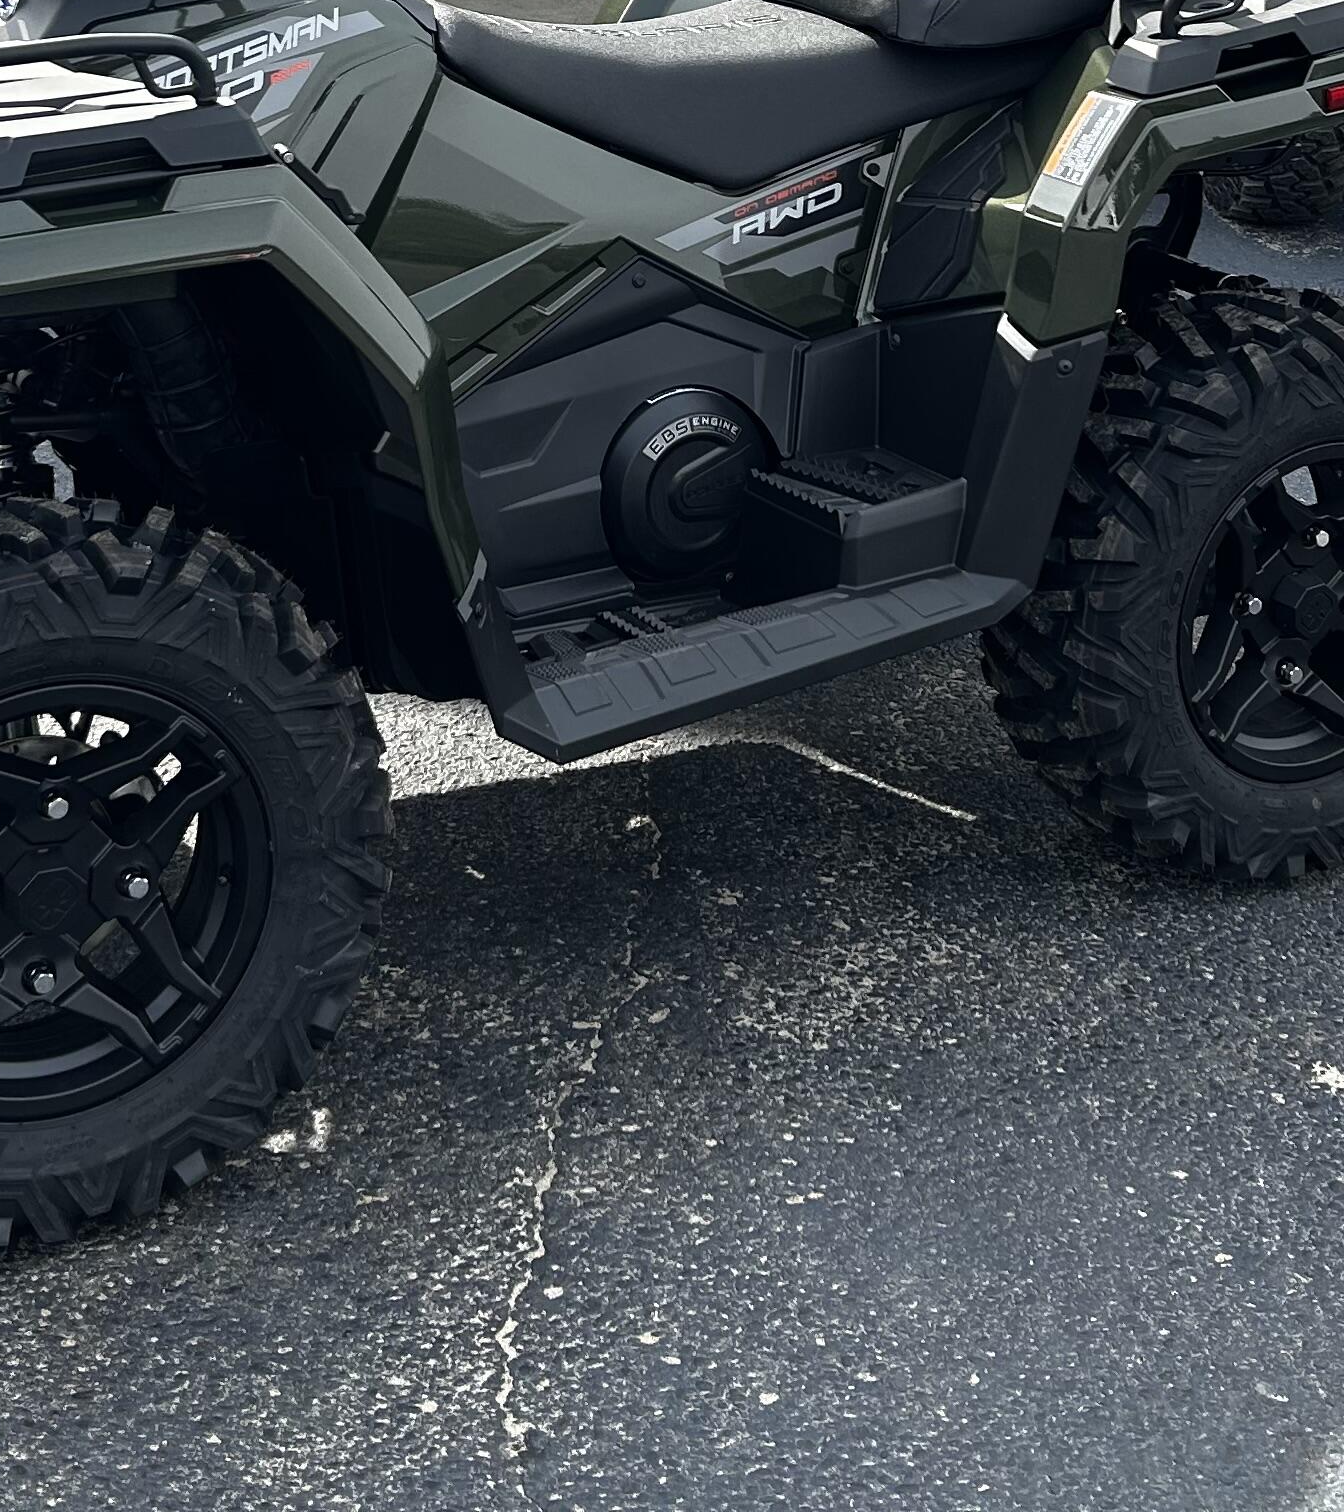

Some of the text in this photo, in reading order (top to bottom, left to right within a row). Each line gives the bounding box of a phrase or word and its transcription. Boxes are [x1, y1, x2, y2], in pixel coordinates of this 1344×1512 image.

[733, 182, 843, 245] AWD
[649, 419, 689, 455] EBS
[692, 415, 739, 435] ENGINE
